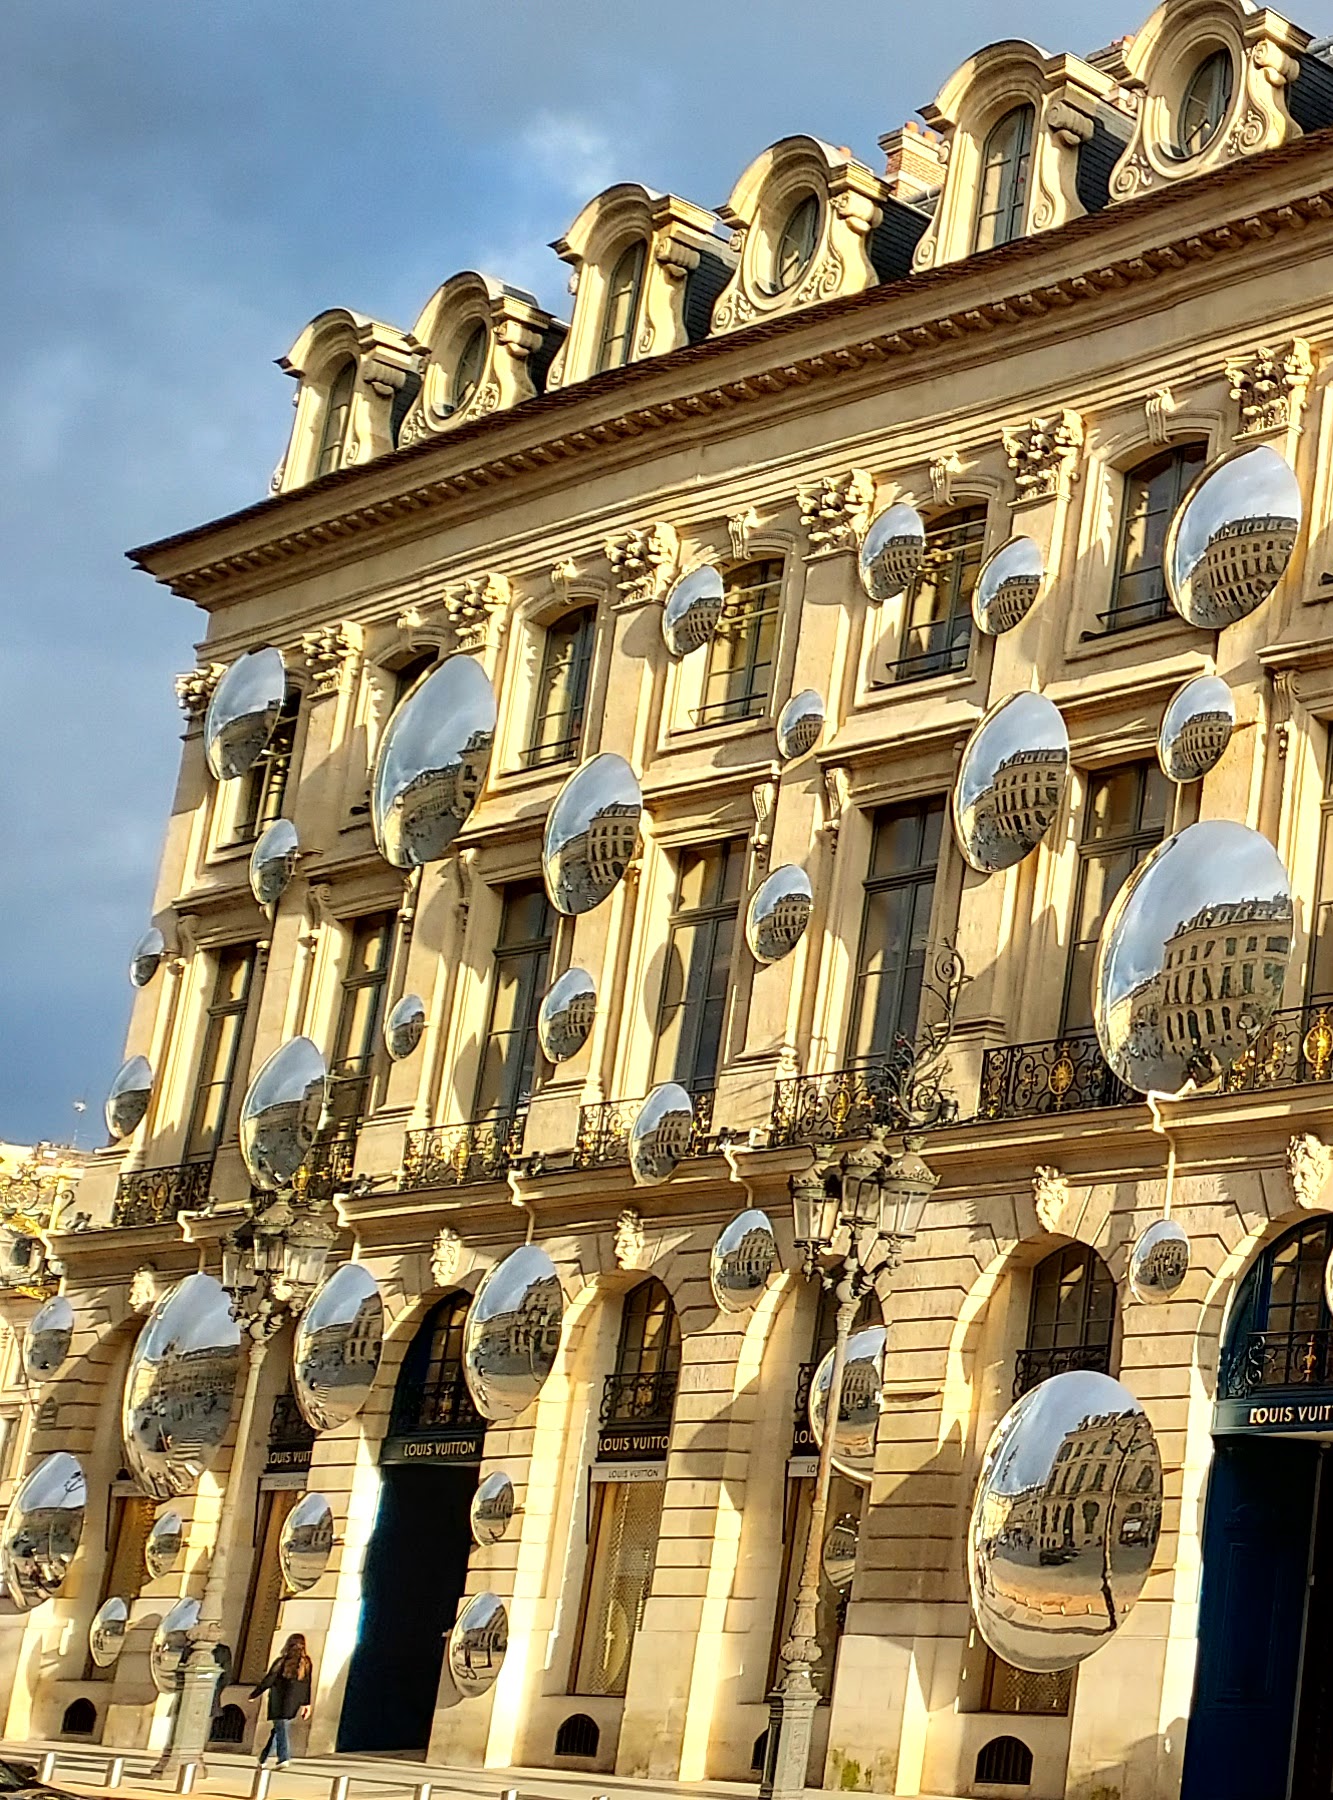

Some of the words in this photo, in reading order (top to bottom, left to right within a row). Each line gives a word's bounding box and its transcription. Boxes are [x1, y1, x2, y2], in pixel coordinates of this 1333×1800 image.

[1250, 1406, 1294, 1423] LOUIS
[404, 1443, 433, 1457] LOUIS
[435, 1440, 476, 1455] VUITTON
[598, 1437, 631, 1451] LOUIS
